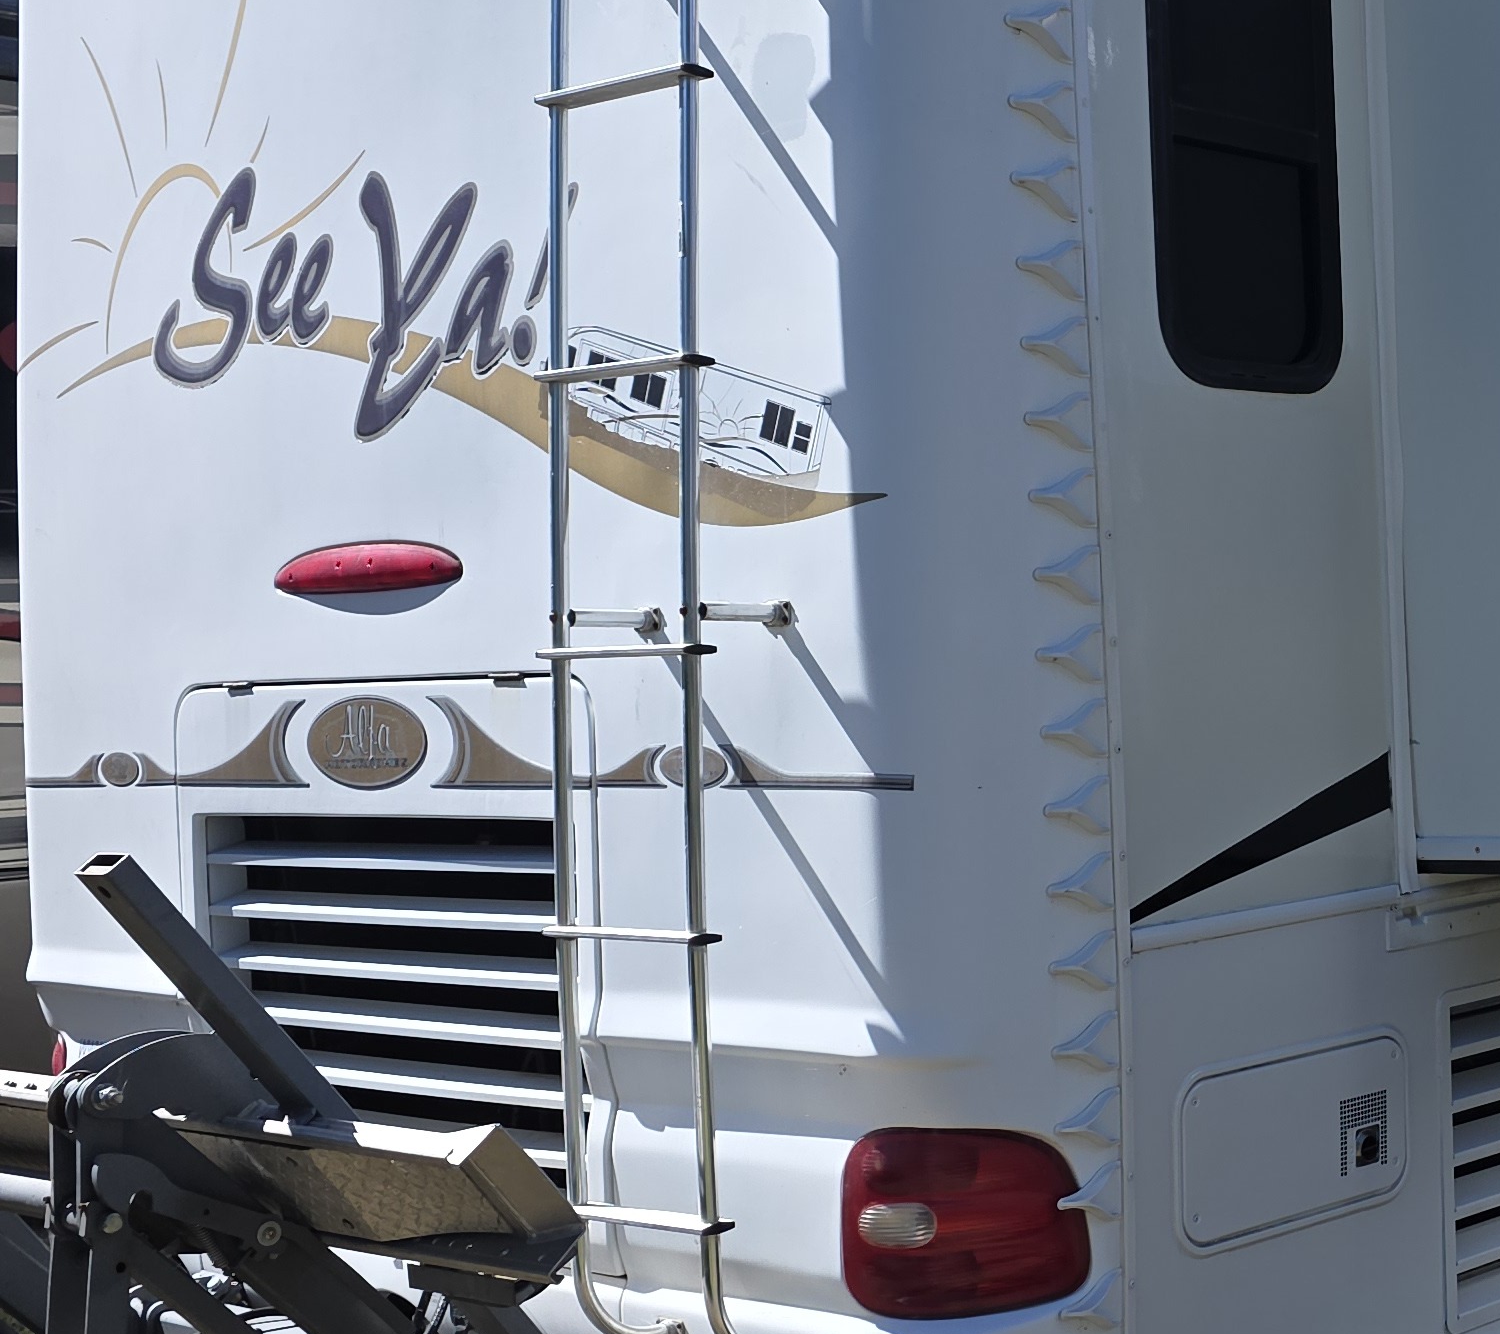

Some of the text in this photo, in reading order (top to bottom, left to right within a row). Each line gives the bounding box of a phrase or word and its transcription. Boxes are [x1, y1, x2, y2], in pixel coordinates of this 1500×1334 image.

[153, 166, 579, 444] See Ya!
[325, 705, 394, 761] Alfa
